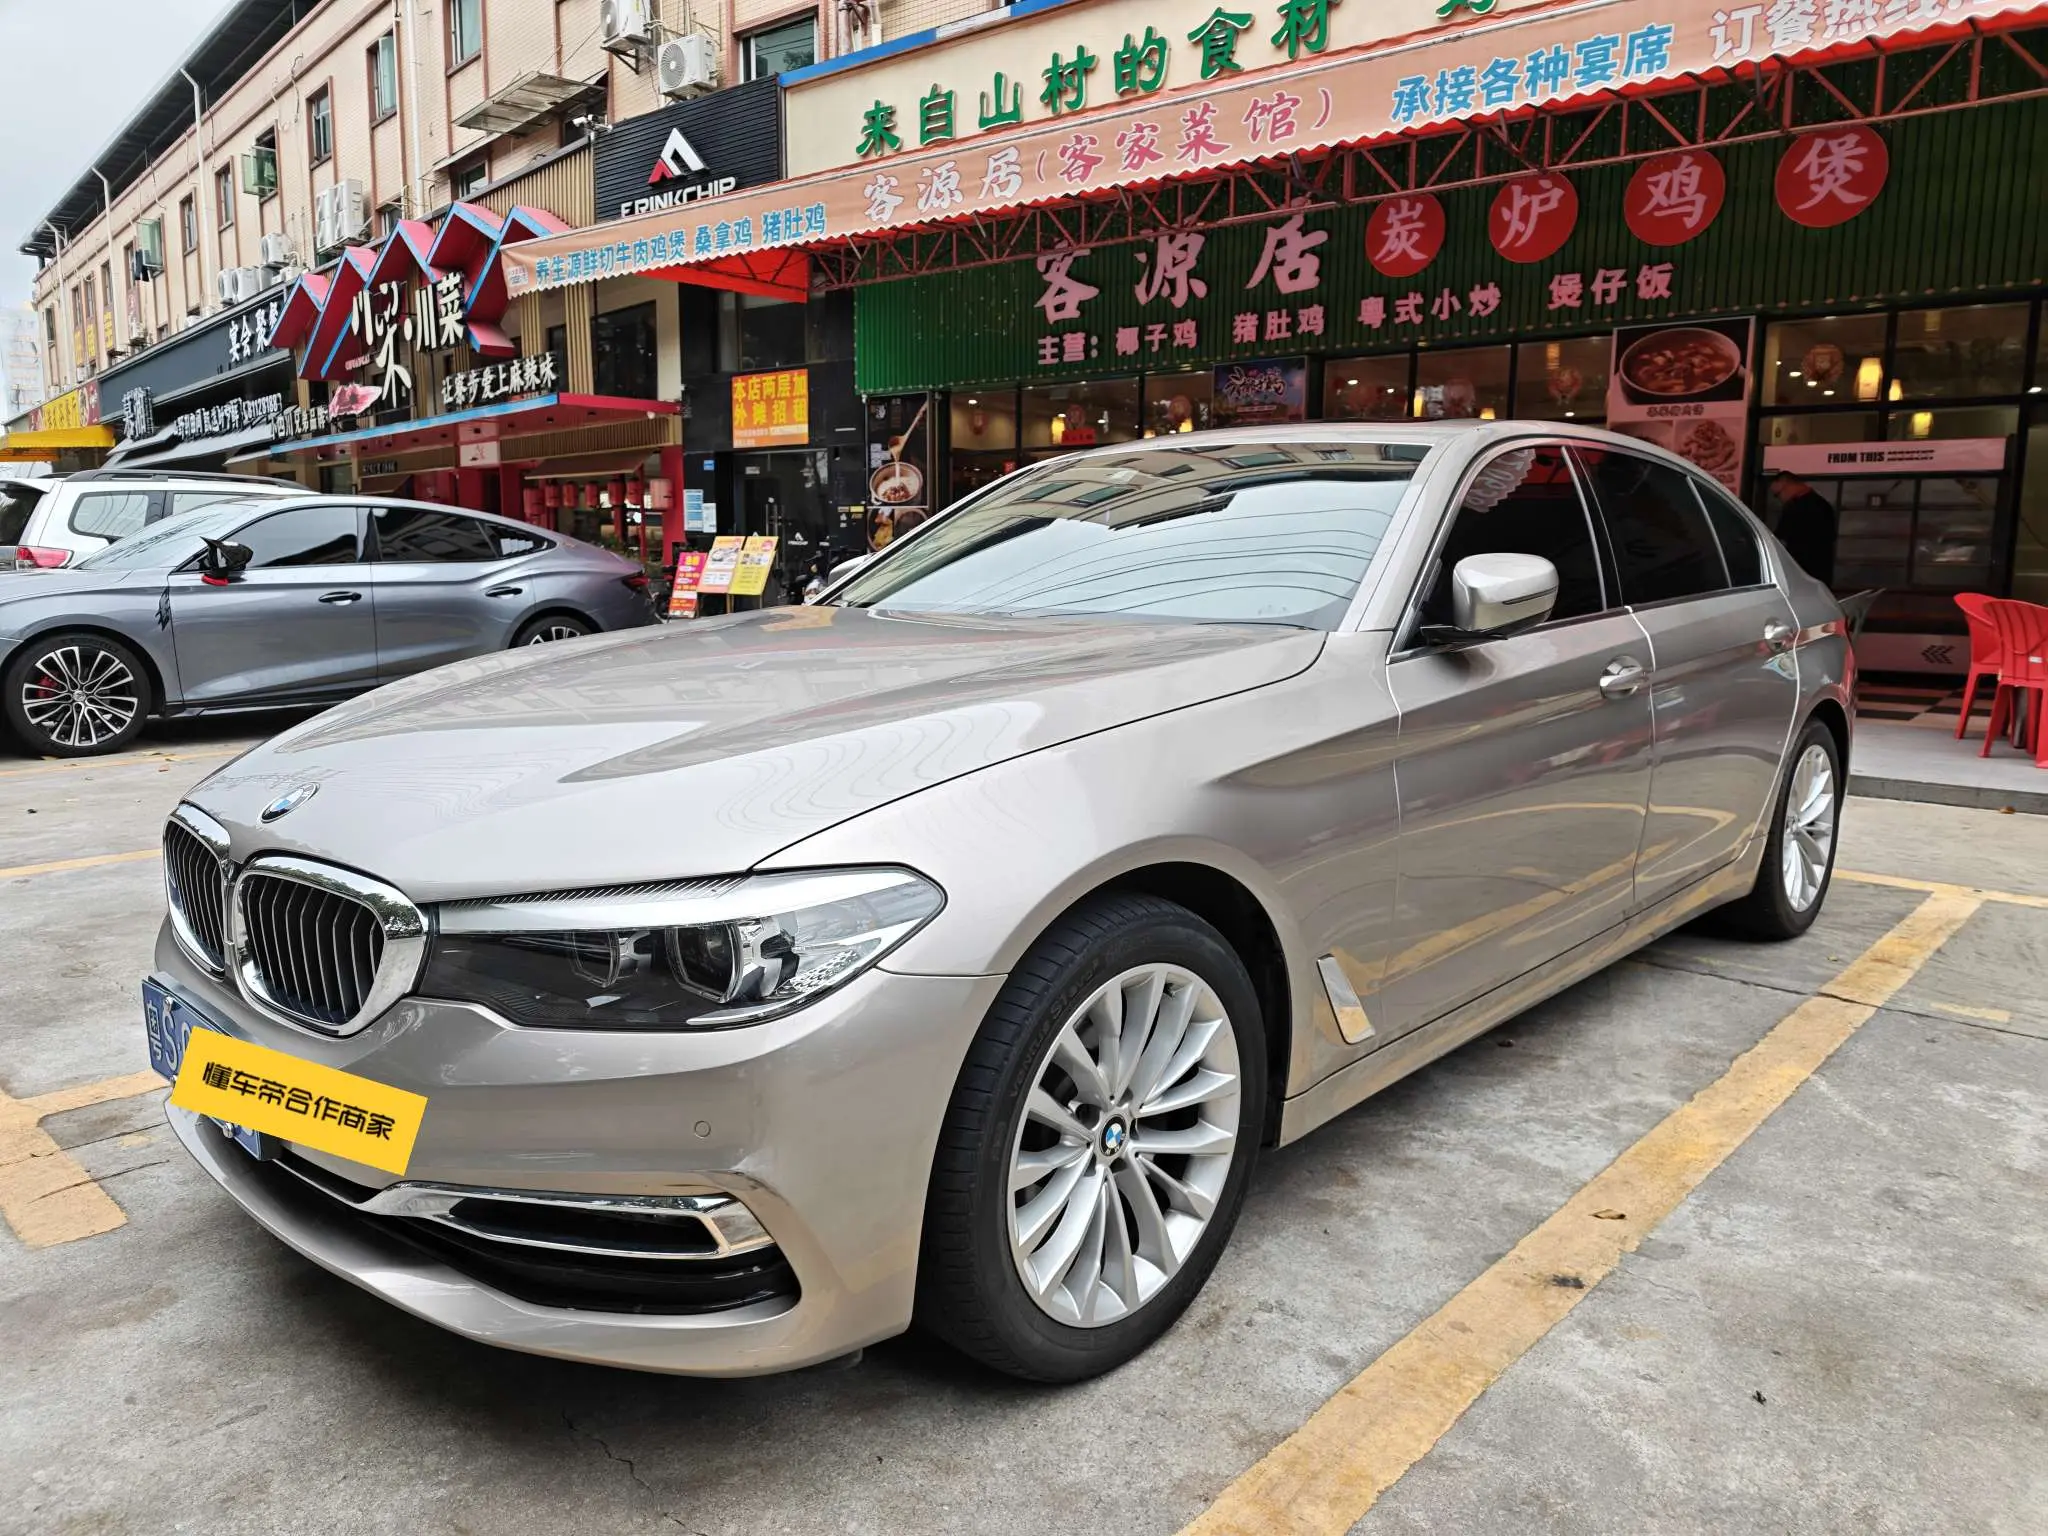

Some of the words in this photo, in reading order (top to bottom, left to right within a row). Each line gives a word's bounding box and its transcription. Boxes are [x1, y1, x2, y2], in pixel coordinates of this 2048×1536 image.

[856, 0, 1337, 156] 来自山村的食材
[535, 232, 687, 287] 养生源鲜切牛肉鸡煲
[695, 219, 753, 256] 桑拿鸡
[762, 202, 826, 247] 猪肚鸡
[1391, 22, 1674, 123] 承接各种宴席
[1034, 200, 1330, 325] 客源居
[1232, 303, 1326, 345] 猪肚鸡
[1357, 284, 1502, 329] 粤式小炒
[1549, 262, 1675, 310] 煲仔饭
[1827, 452, 1858, 464] FROM
[1859, 451, 1885, 463] THIS
